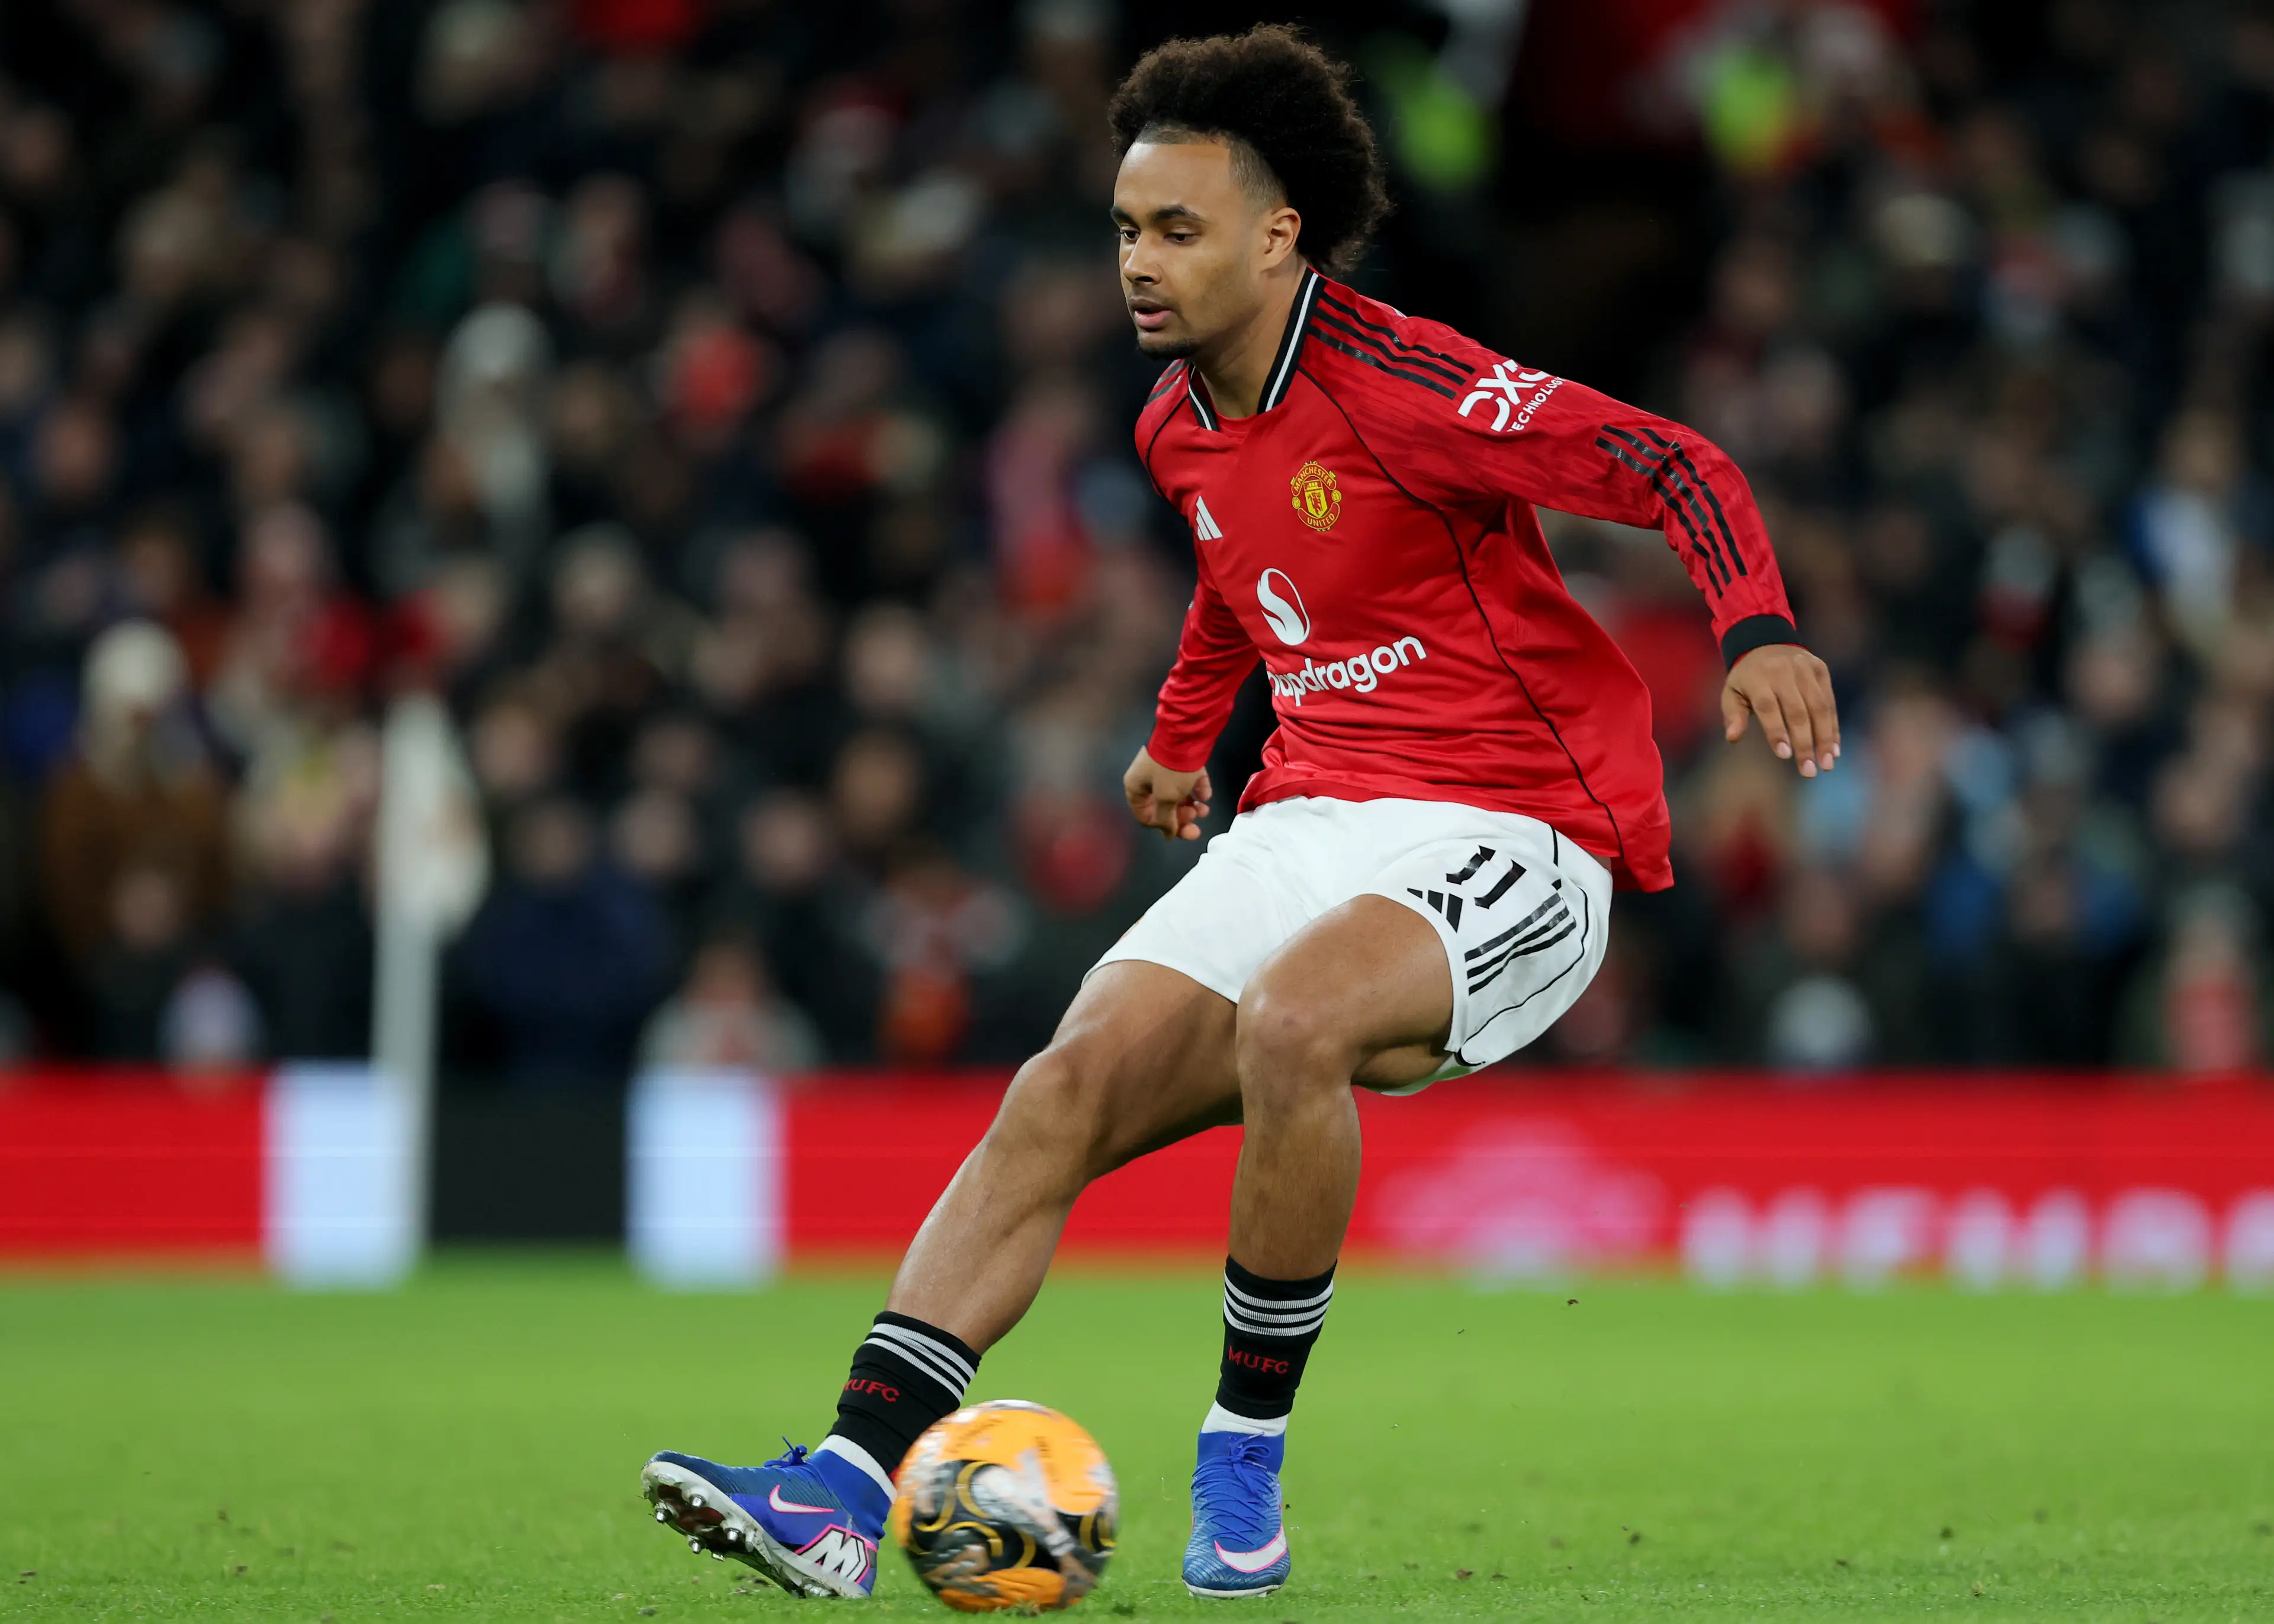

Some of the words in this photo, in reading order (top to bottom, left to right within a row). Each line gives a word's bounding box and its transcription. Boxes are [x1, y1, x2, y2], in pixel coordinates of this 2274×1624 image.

[1507, 377, 1566, 432] ECHNOLOGY
[1295, 467, 1333, 491] MANCHESTER
[1307, 513, 1335, 527] UNITED
[1266, 637, 1427, 707] napdragon
[1446, 844, 1527, 909] 11
[1228, 1345, 1291, 1374] MUFC
